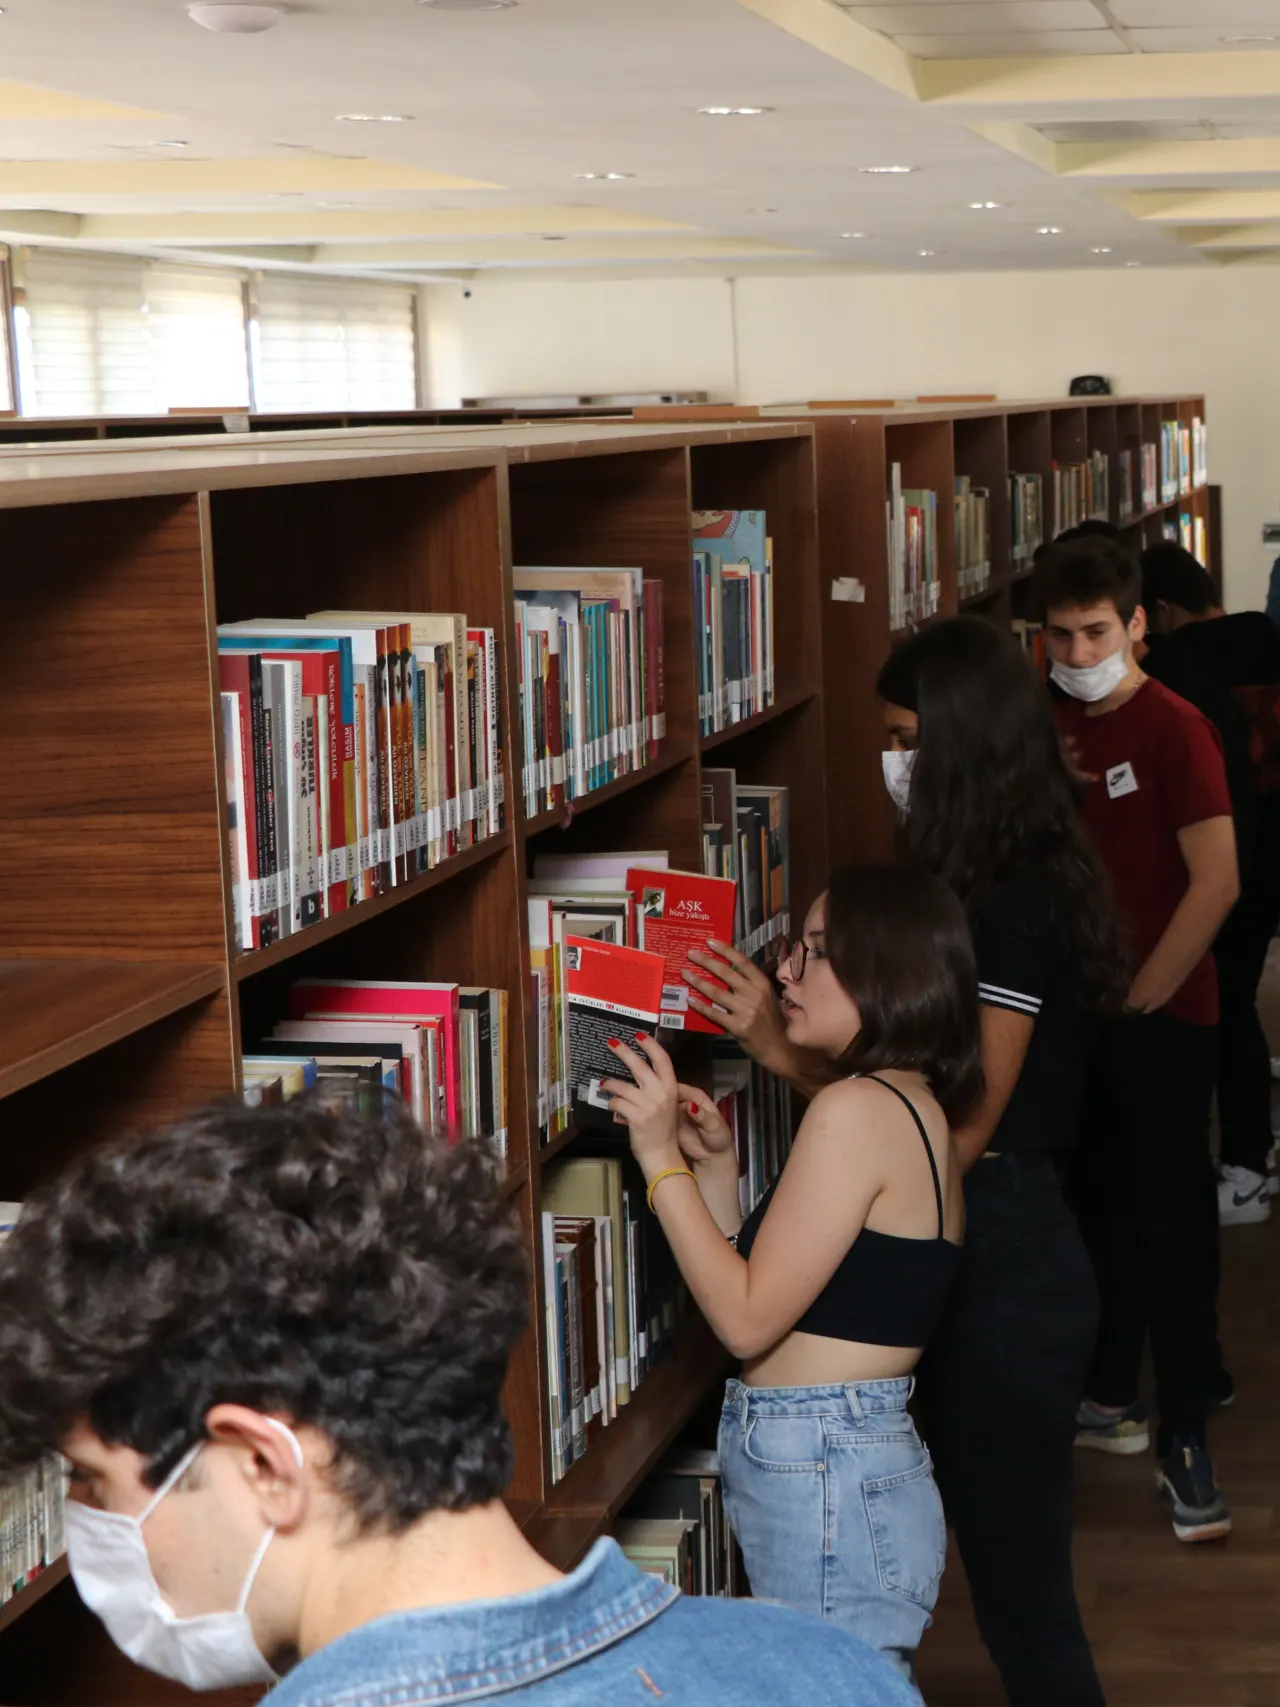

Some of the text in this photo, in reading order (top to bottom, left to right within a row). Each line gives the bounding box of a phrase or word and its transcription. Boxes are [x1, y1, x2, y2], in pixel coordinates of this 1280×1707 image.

[677, 899, 703, 913] AŞK
[668, 907, 710, 921] bize yakıştı
